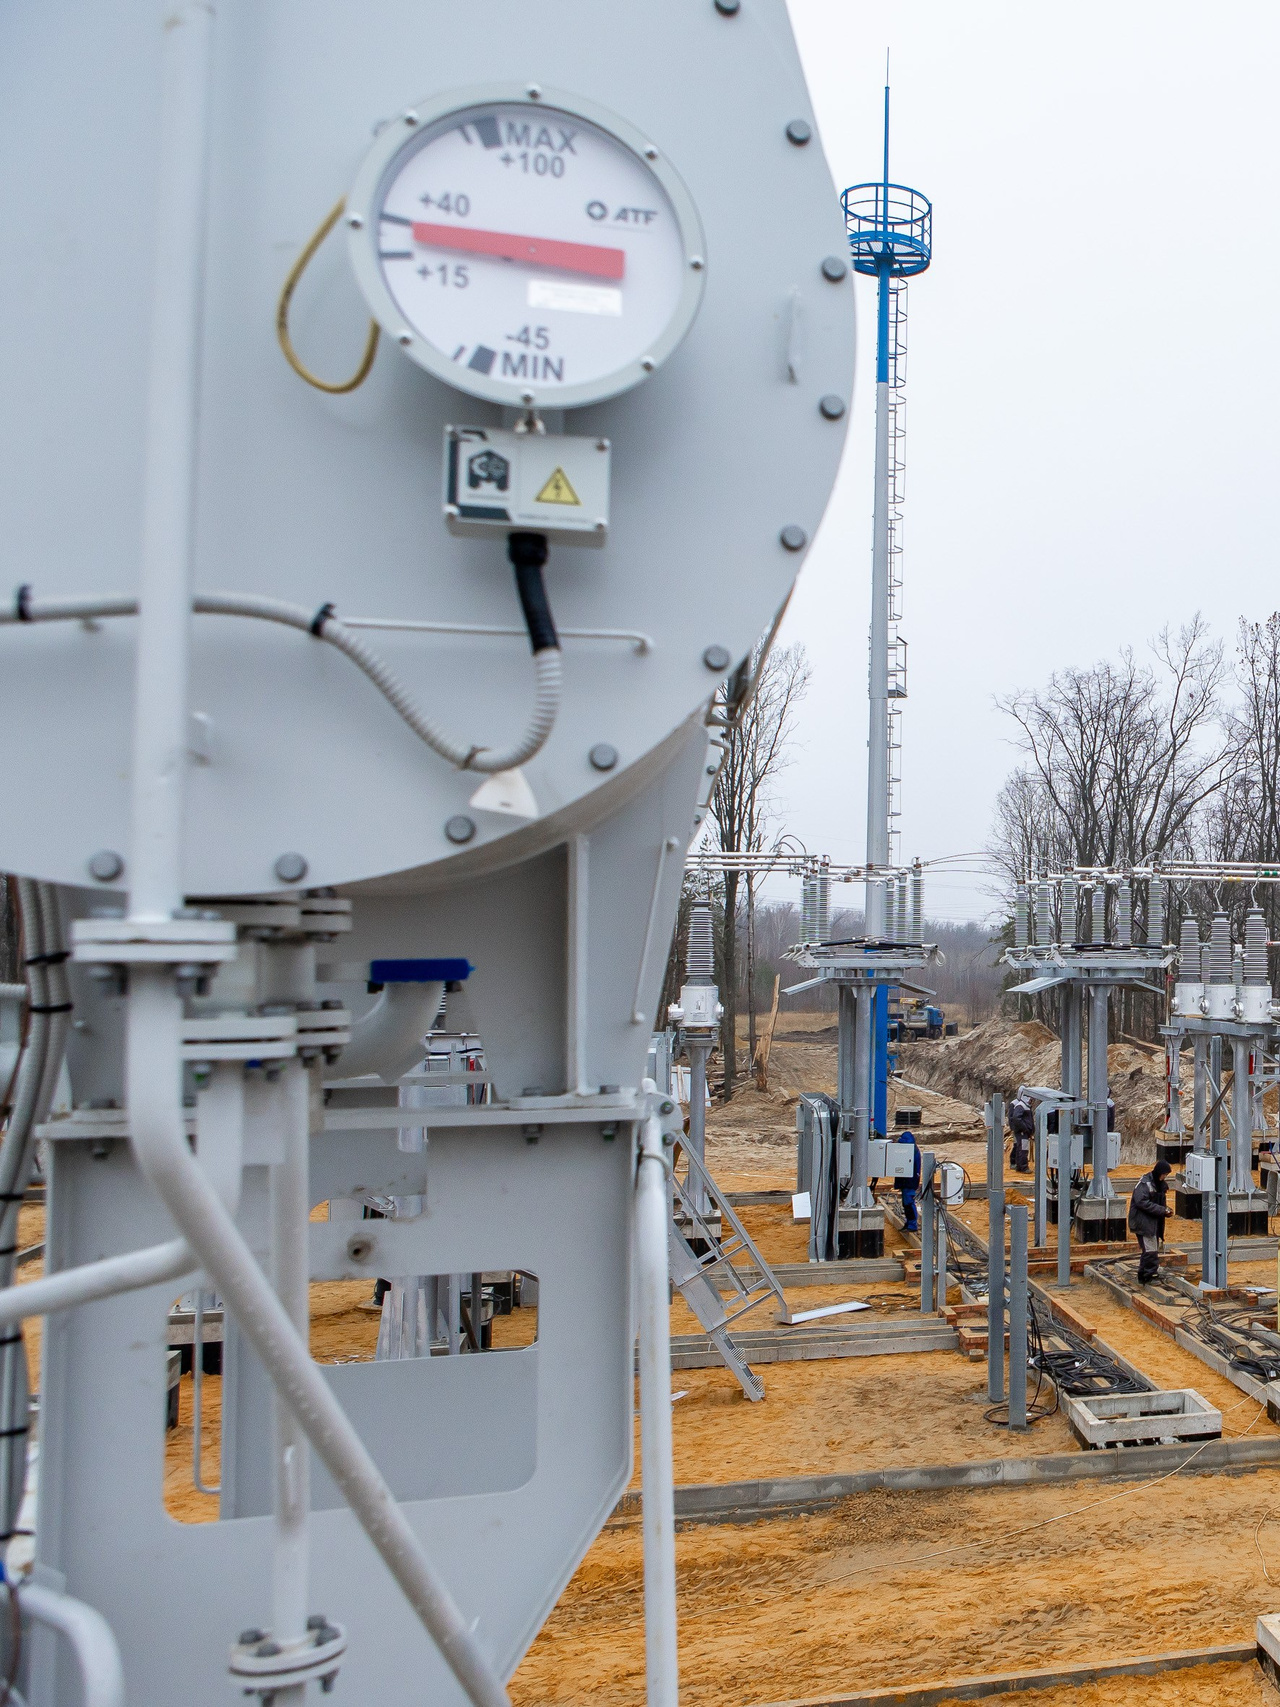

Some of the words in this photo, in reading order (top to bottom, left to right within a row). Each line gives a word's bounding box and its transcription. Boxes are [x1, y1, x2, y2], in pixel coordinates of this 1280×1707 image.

[506, 123, 578, 155] MAX
[500, 152, 565, 179] +100
[419, 193, 471, 217] +40
[416, 265, 470, 288] +15
[506, 325, 551, 350] -45
[502, 352, 565, 382] MIN
